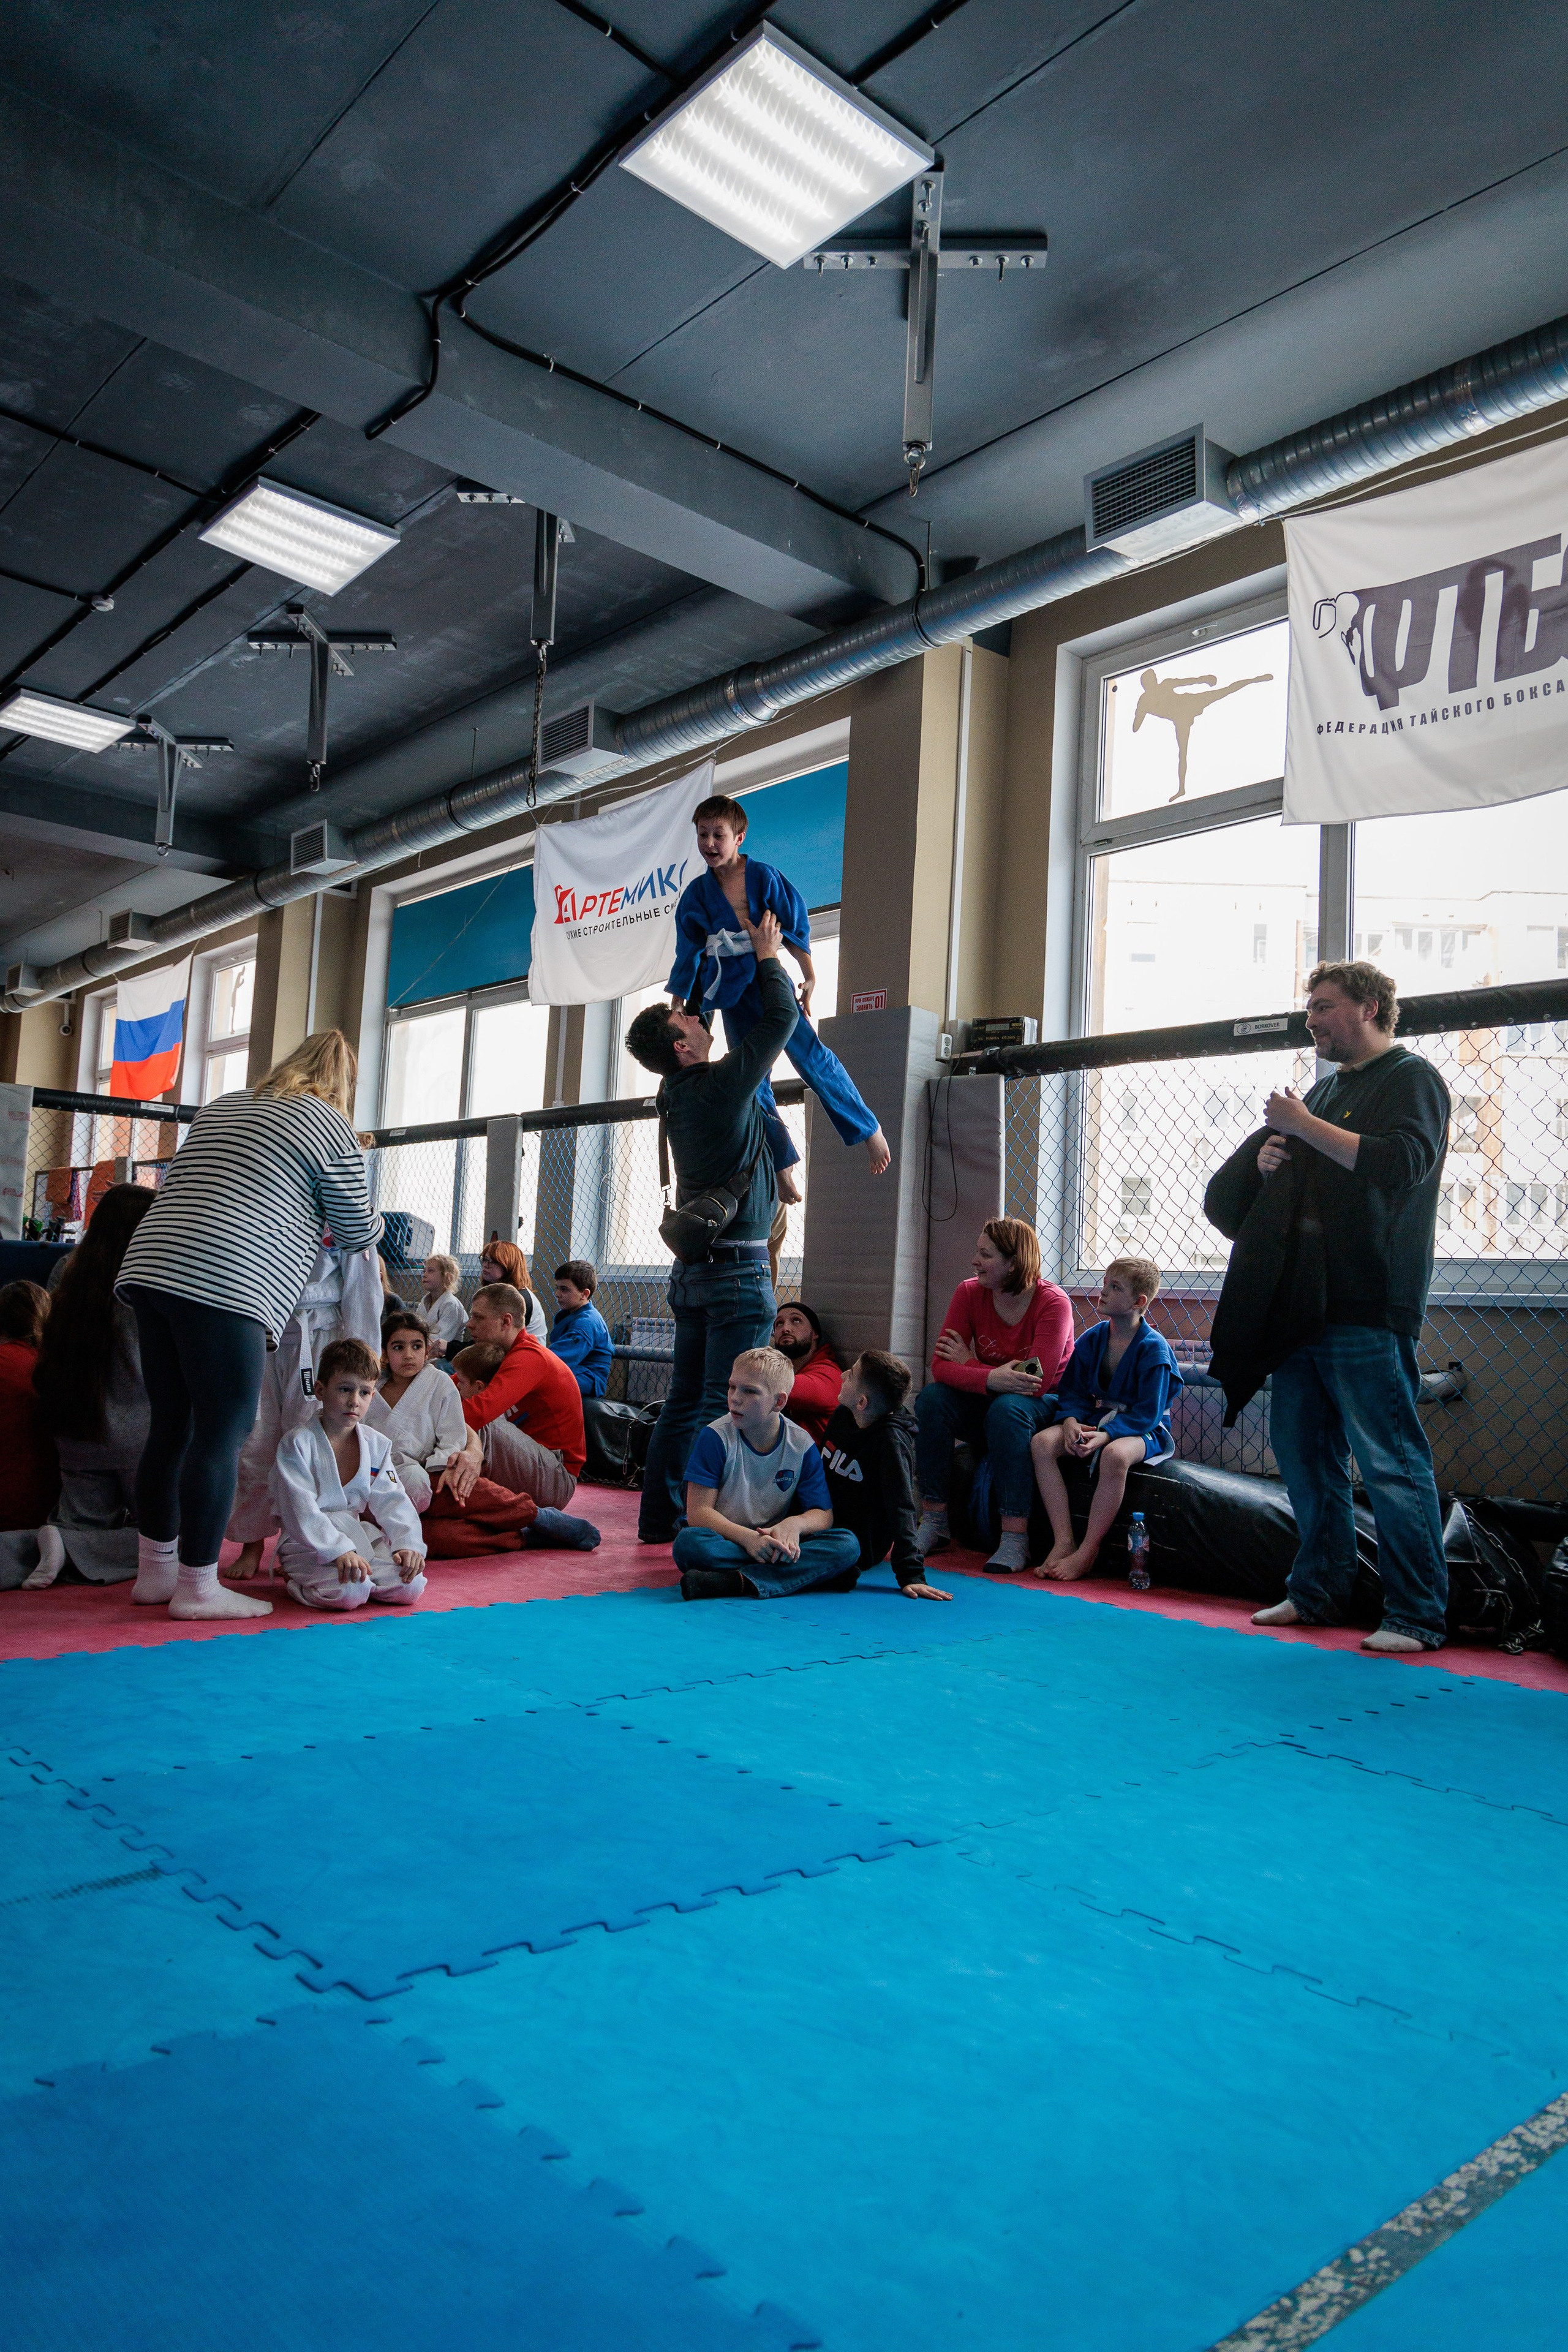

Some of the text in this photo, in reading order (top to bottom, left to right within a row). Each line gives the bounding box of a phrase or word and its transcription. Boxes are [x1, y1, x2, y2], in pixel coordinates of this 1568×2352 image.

[1316, 679, 1566, 735] ФЕДЕРАЦИЯ ТАЙСКОГО БОКСА
[566, 890, 681, 940] СУХИЕ СТРОИТЕЛЬНЫЕ СМЕ
[875, 995, 883, 1009] 01
[821, 1440, 864, 1482] FILA
